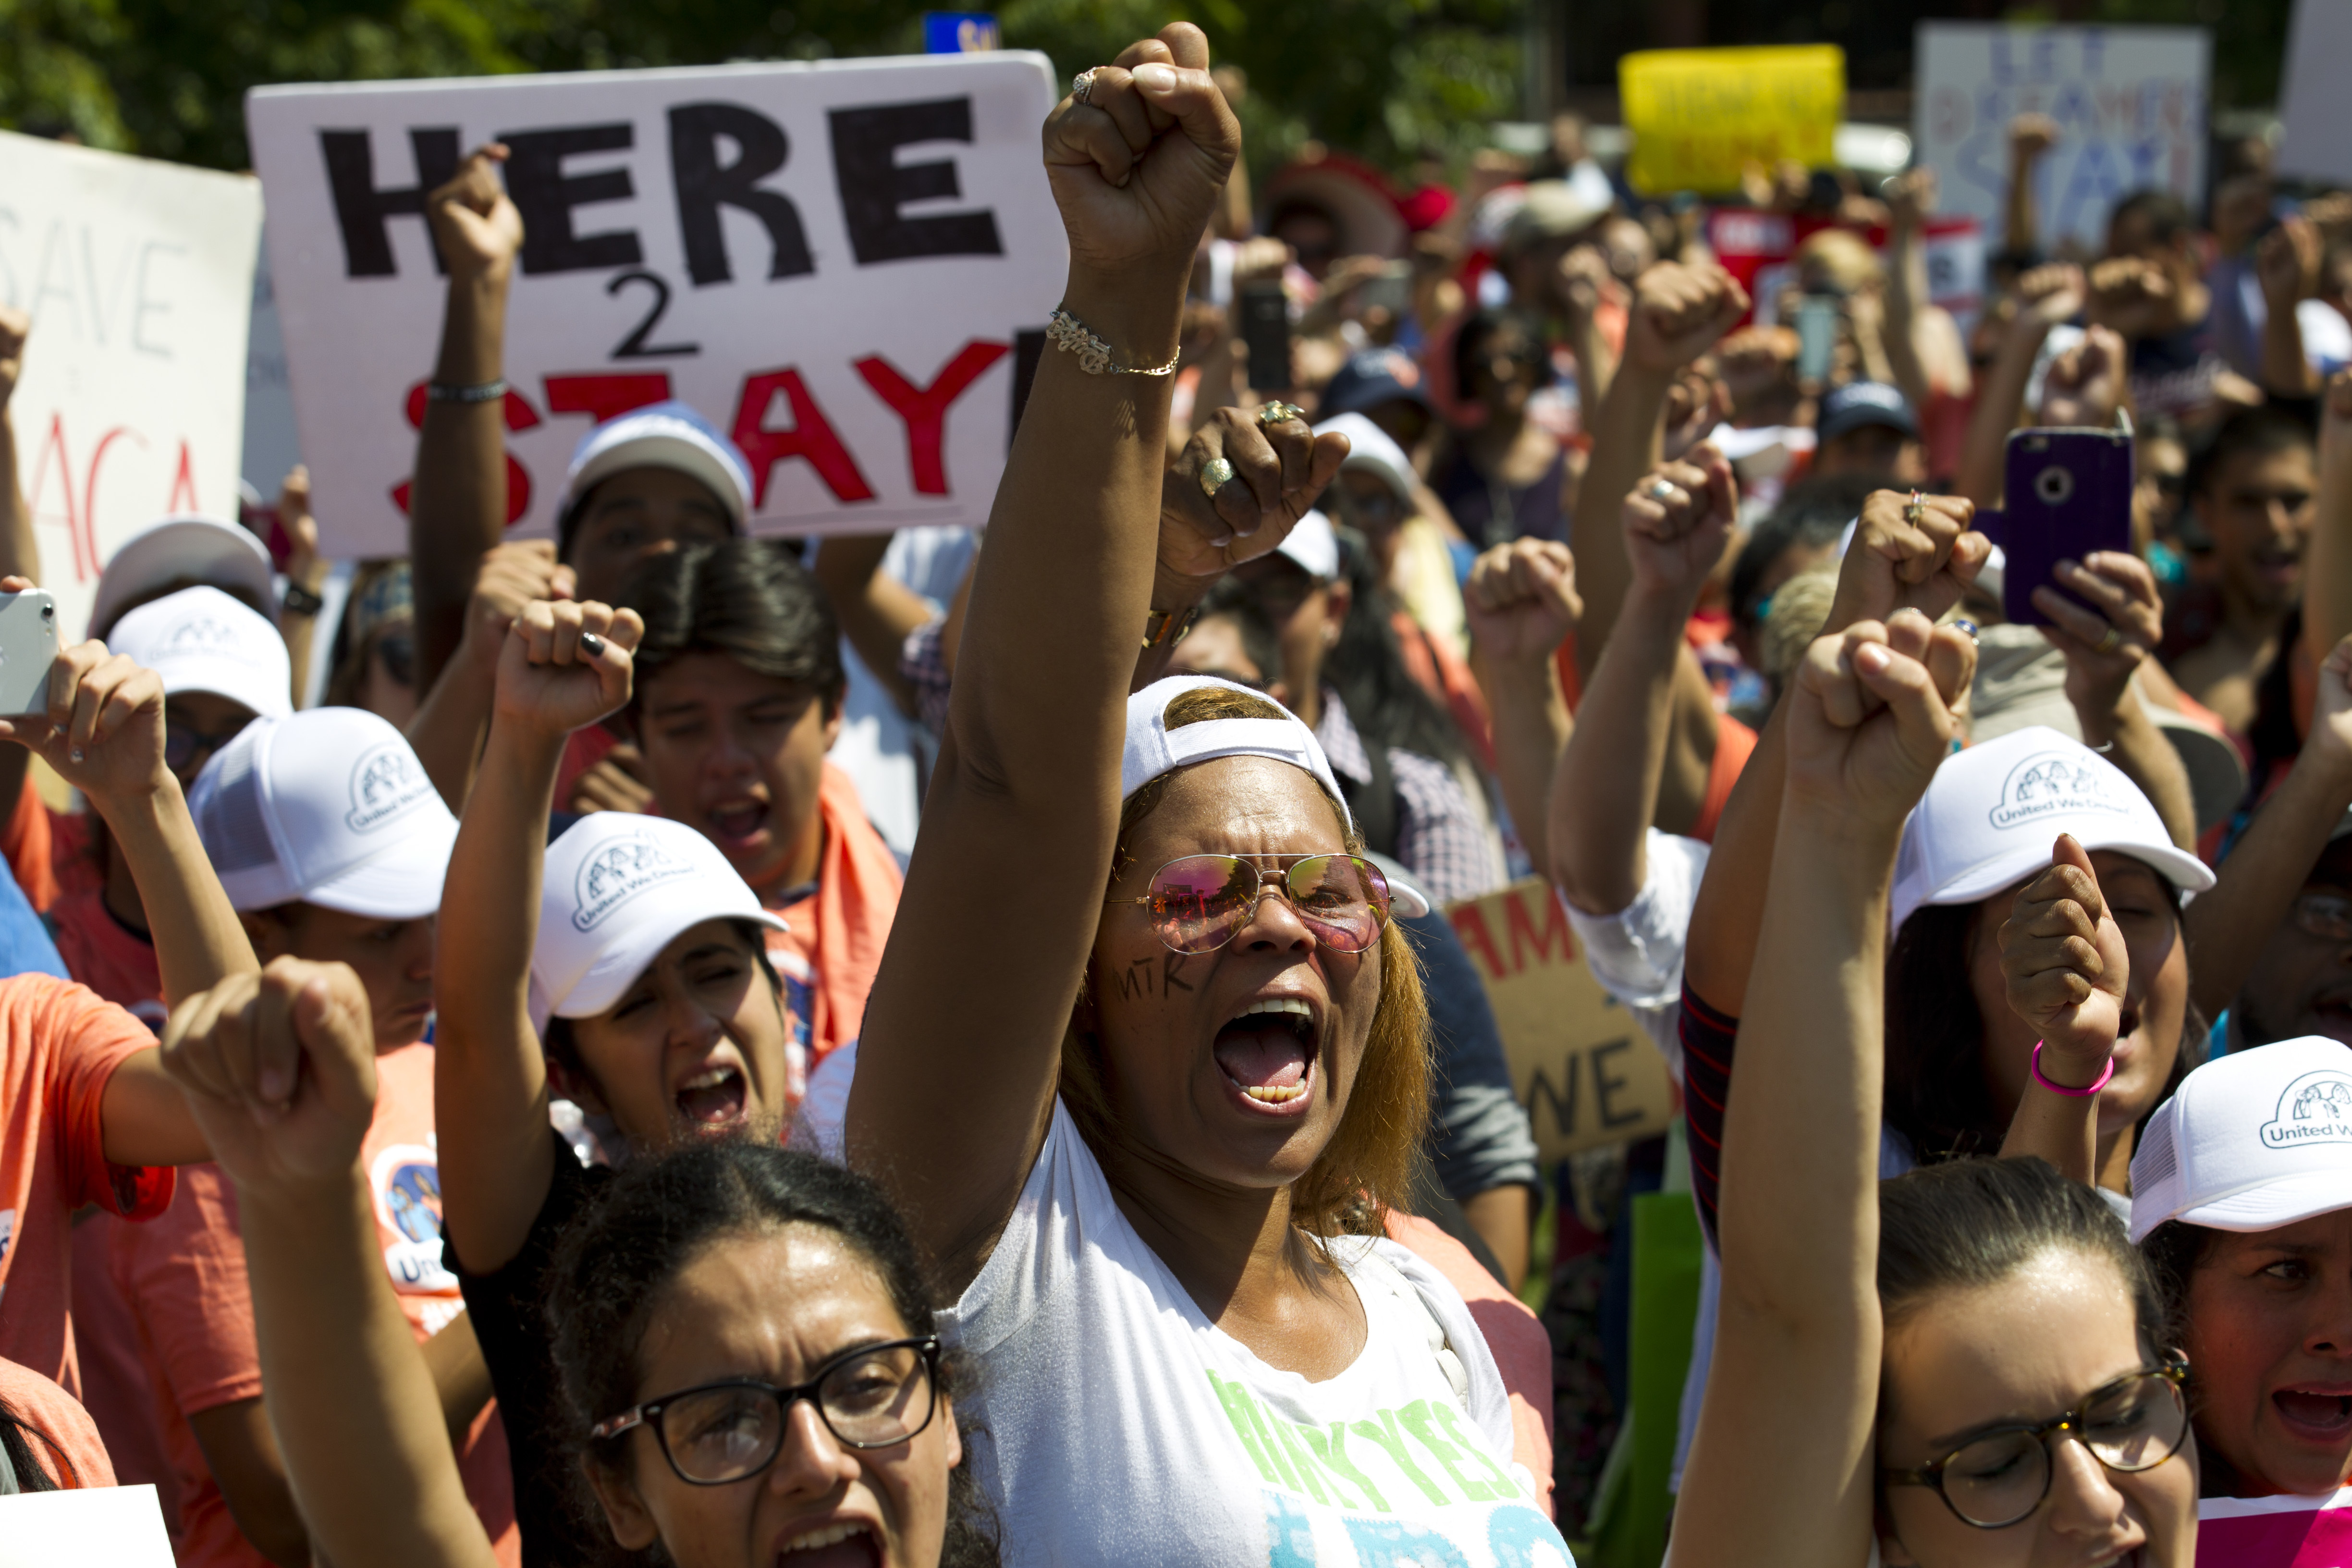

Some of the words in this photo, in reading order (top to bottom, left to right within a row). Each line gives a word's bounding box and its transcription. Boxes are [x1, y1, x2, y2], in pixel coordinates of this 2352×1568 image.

[317, 95, 1006, 289] HERE
[606, 268, 700, 360] 2
[1998, 800, 2055, 822] United
[579, 887, 626, 924] United
[2270, 1124, 2333, 1141] United
